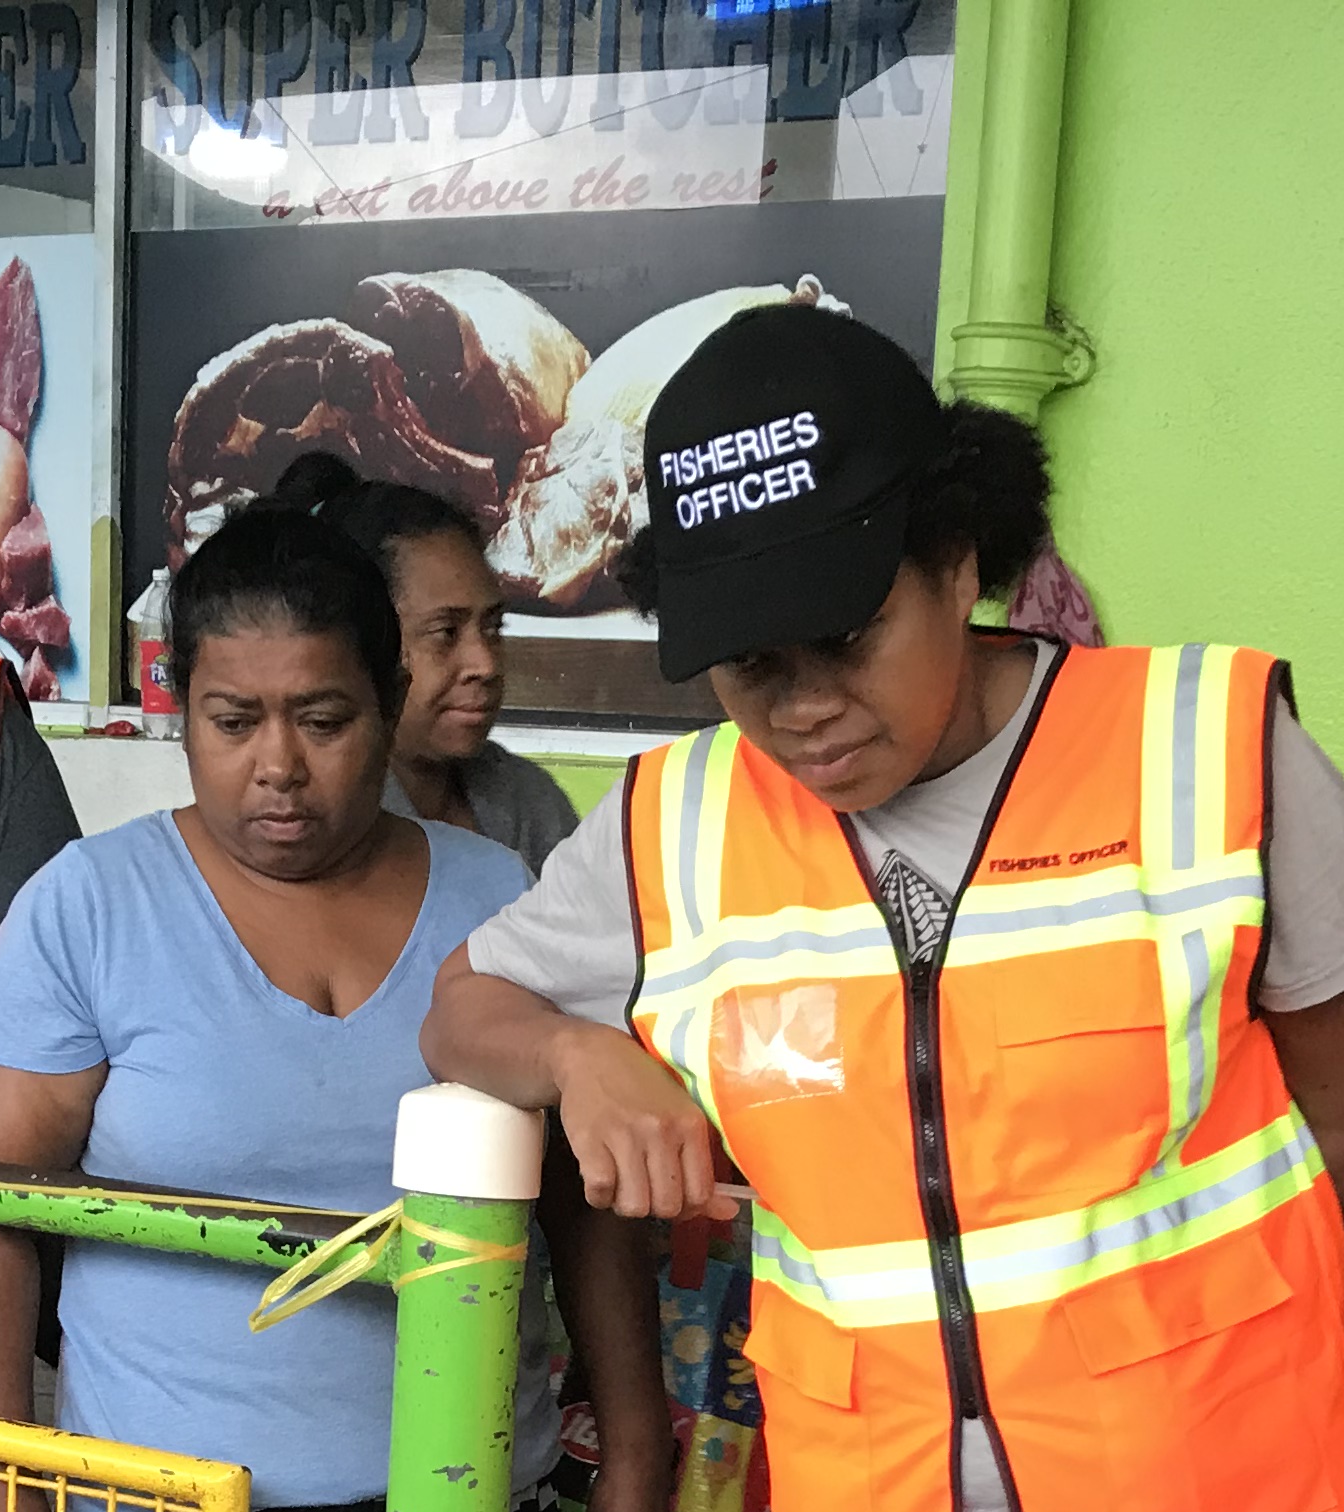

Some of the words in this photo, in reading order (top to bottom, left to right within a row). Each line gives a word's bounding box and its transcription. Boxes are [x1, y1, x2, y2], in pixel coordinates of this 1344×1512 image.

[148, 0, 430, 156] SUPER
[454, 0, 924, 140] BUTCHER
[262, 189, 294, 218] a
[314, 178, 389, 217] cut
[408, 159, 555, 214] above
[569, 155, 650, 209] the
[672, 158, 779, 204] rest
[659, 411, 820, 489] FISHERIES
[676, 458, 817, 530] OFFICER
[989, 852, 1062, 873] FISHERIES
[1068, 839, 1129, 866] OFFICER
